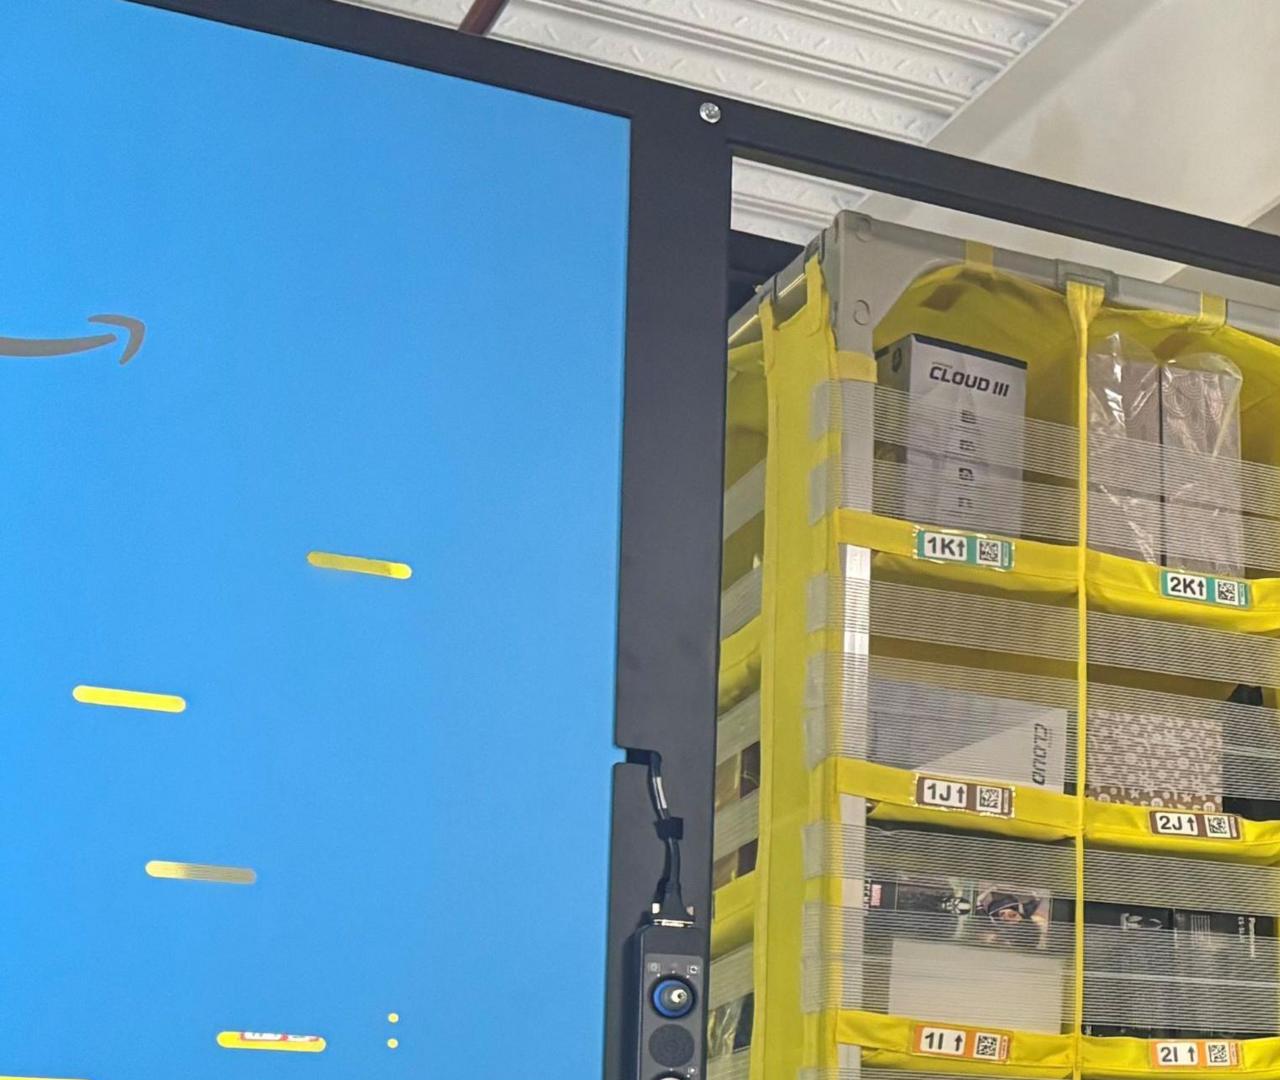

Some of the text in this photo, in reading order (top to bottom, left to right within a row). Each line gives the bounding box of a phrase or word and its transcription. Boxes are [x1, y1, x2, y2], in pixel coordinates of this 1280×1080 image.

[929, 366, 1010, 397] CLOUD III
[926, 536, 955, 557] 1K
[1169, 576, 1197, 595] 2K
[927, 782, 950, 802] 1J
[1159, 816, 1182, 832] 2J
